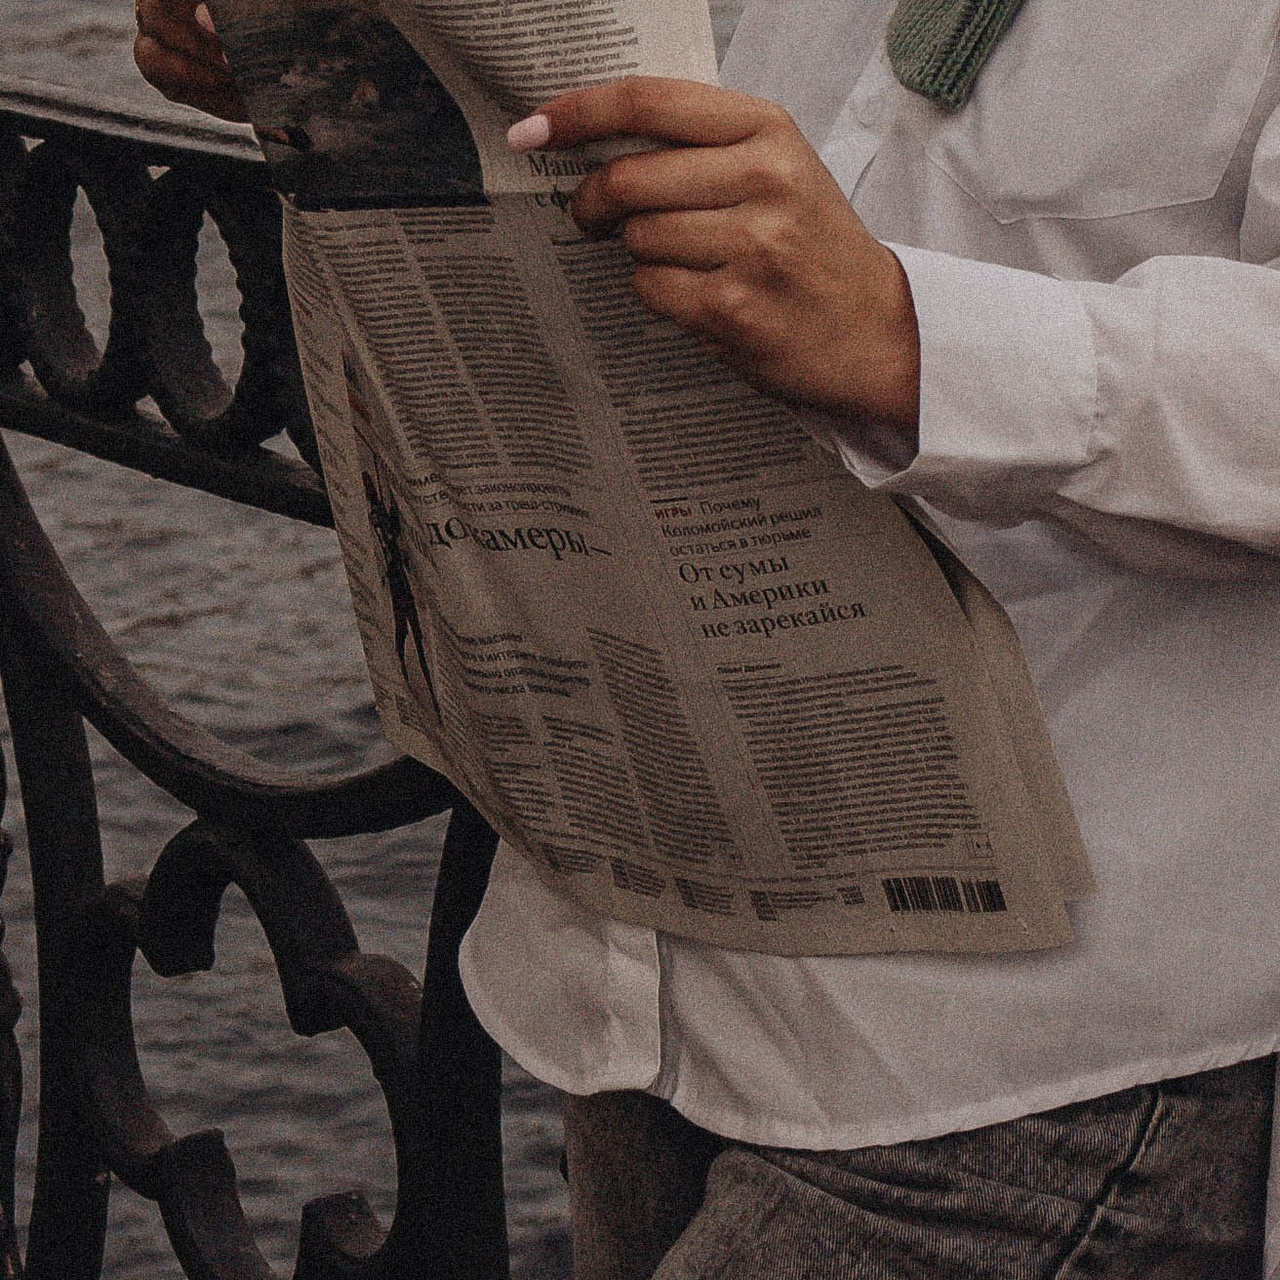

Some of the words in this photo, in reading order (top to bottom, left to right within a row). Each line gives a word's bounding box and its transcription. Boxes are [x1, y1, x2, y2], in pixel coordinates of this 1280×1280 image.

[700, 496, 761, 516] Почему
[661, 515, 768, 538] Коломойский
[770, 506, 823, 526] решил
[669, 541, 737, 557] остаться
[740, 539, 749, 549] в
[751, 527, 812, 547] тюрьме
[678, 562, 714, 584] От
[719, 556, 790, 585] сумы
[689, 595, 708, 612] и
[712, 579, 831, 610] Америки
[700, 622, 731, 639] не
[733, 602, 868, 638] зарекайся
